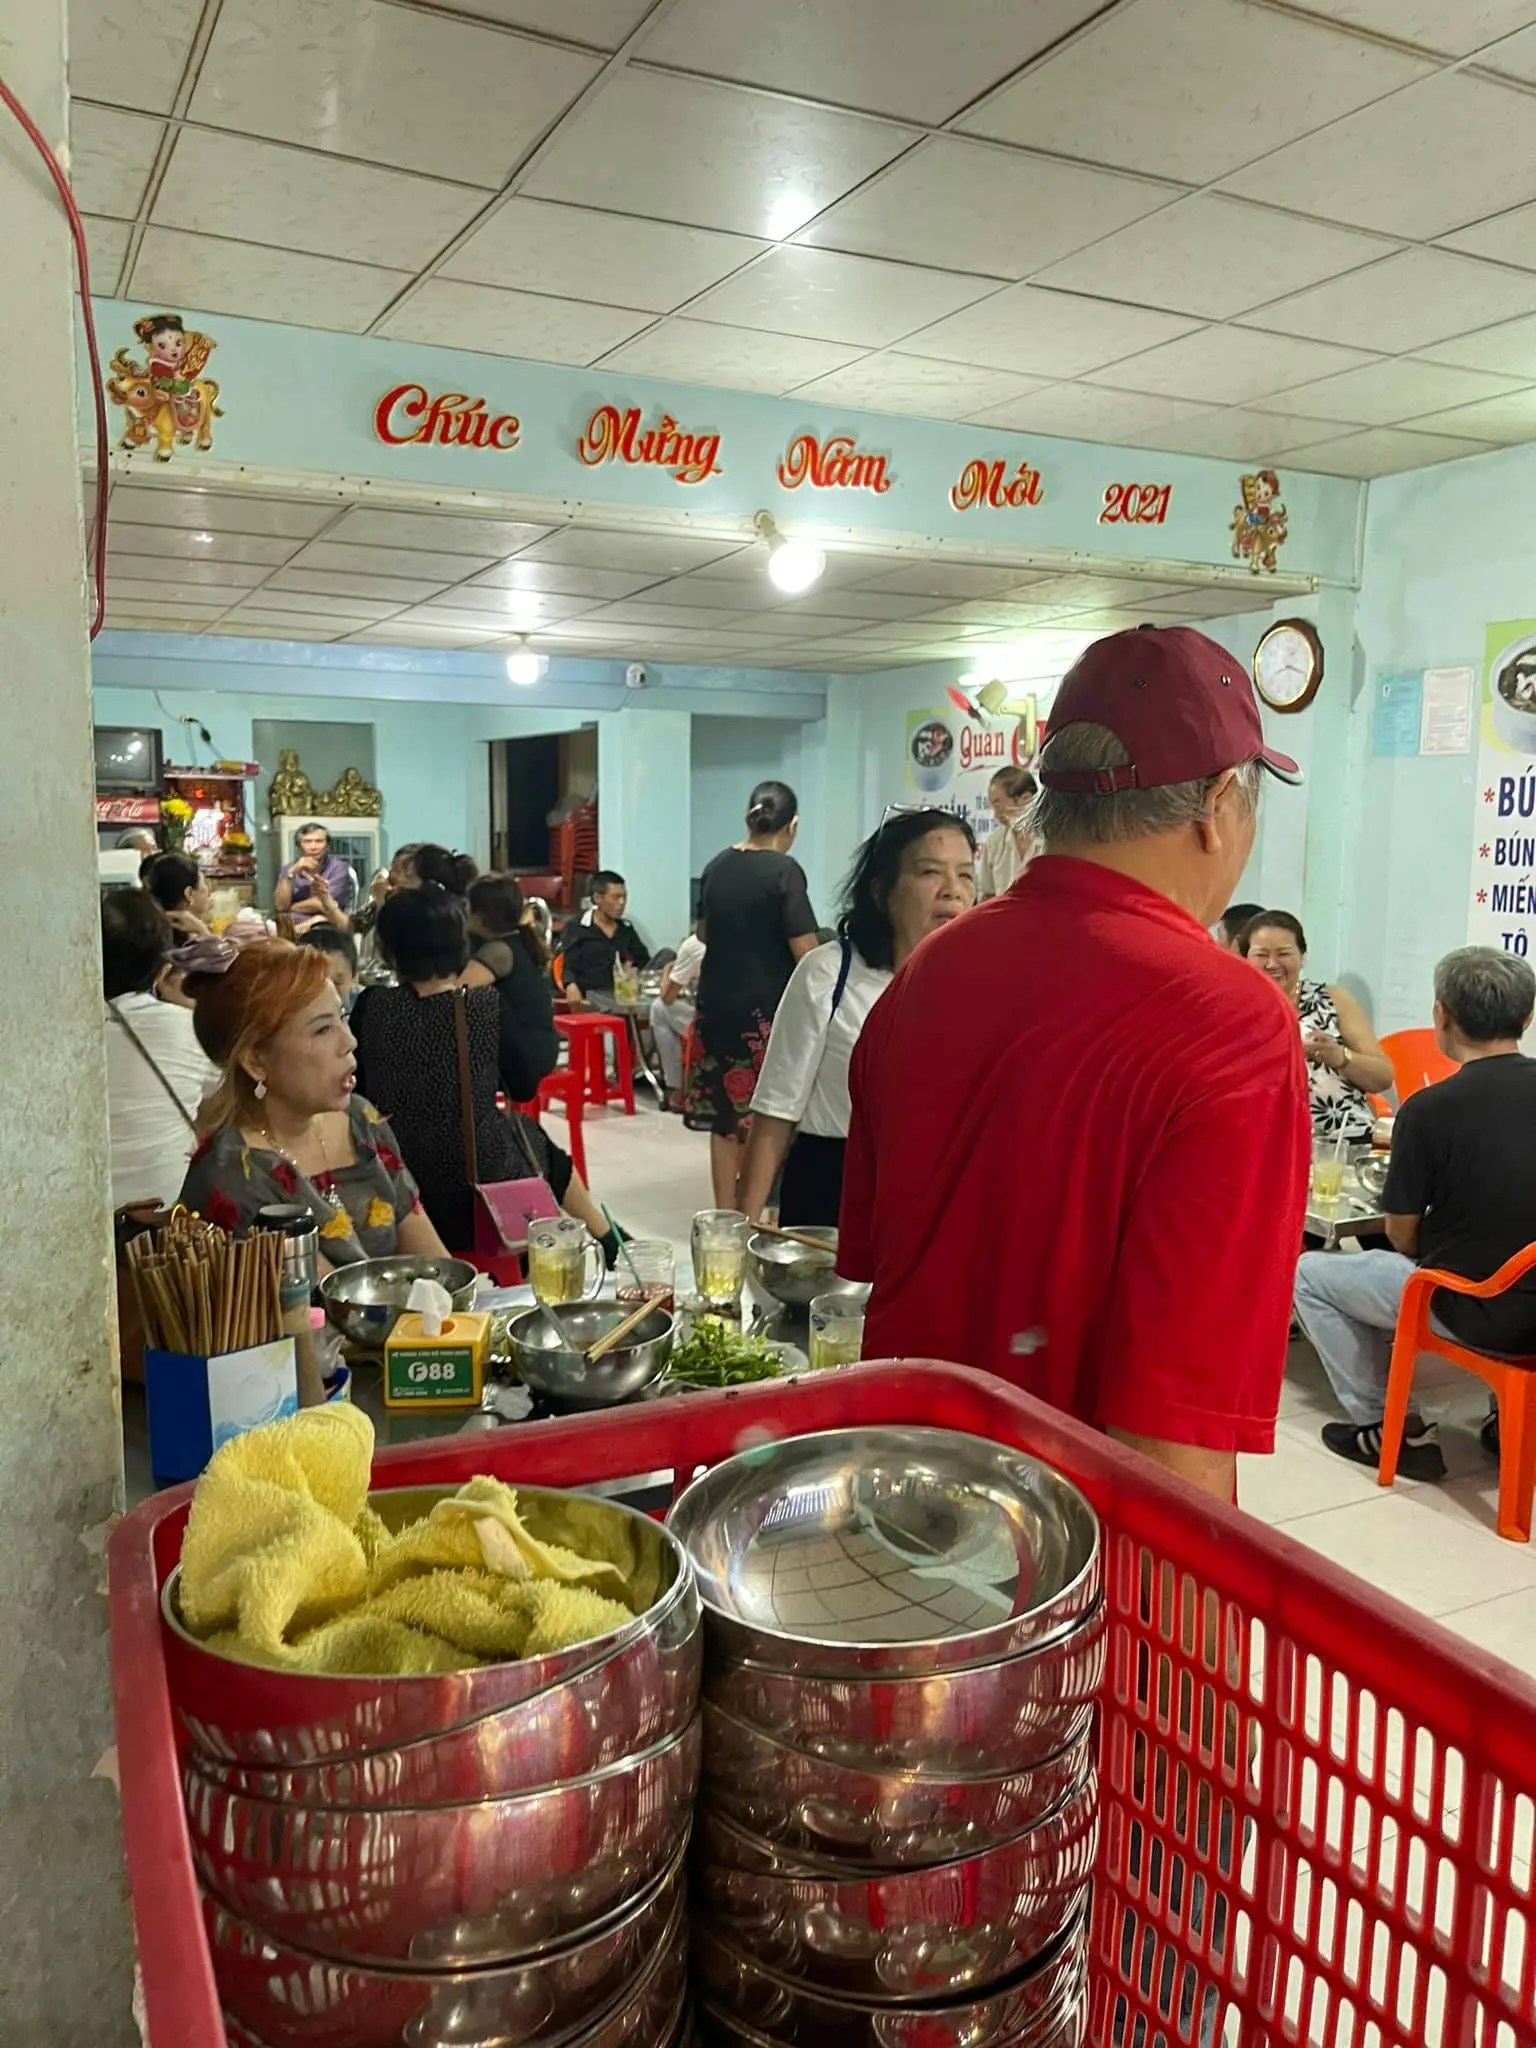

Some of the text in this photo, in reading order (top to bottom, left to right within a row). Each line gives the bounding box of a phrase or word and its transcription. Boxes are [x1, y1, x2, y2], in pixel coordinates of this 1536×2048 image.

[375, 383, 1173, 525] Chúc Mừng Năm Mới 2021
[1494, 829, 1536, 868] BÚN
[407, 1361, 456, 1382] F88
